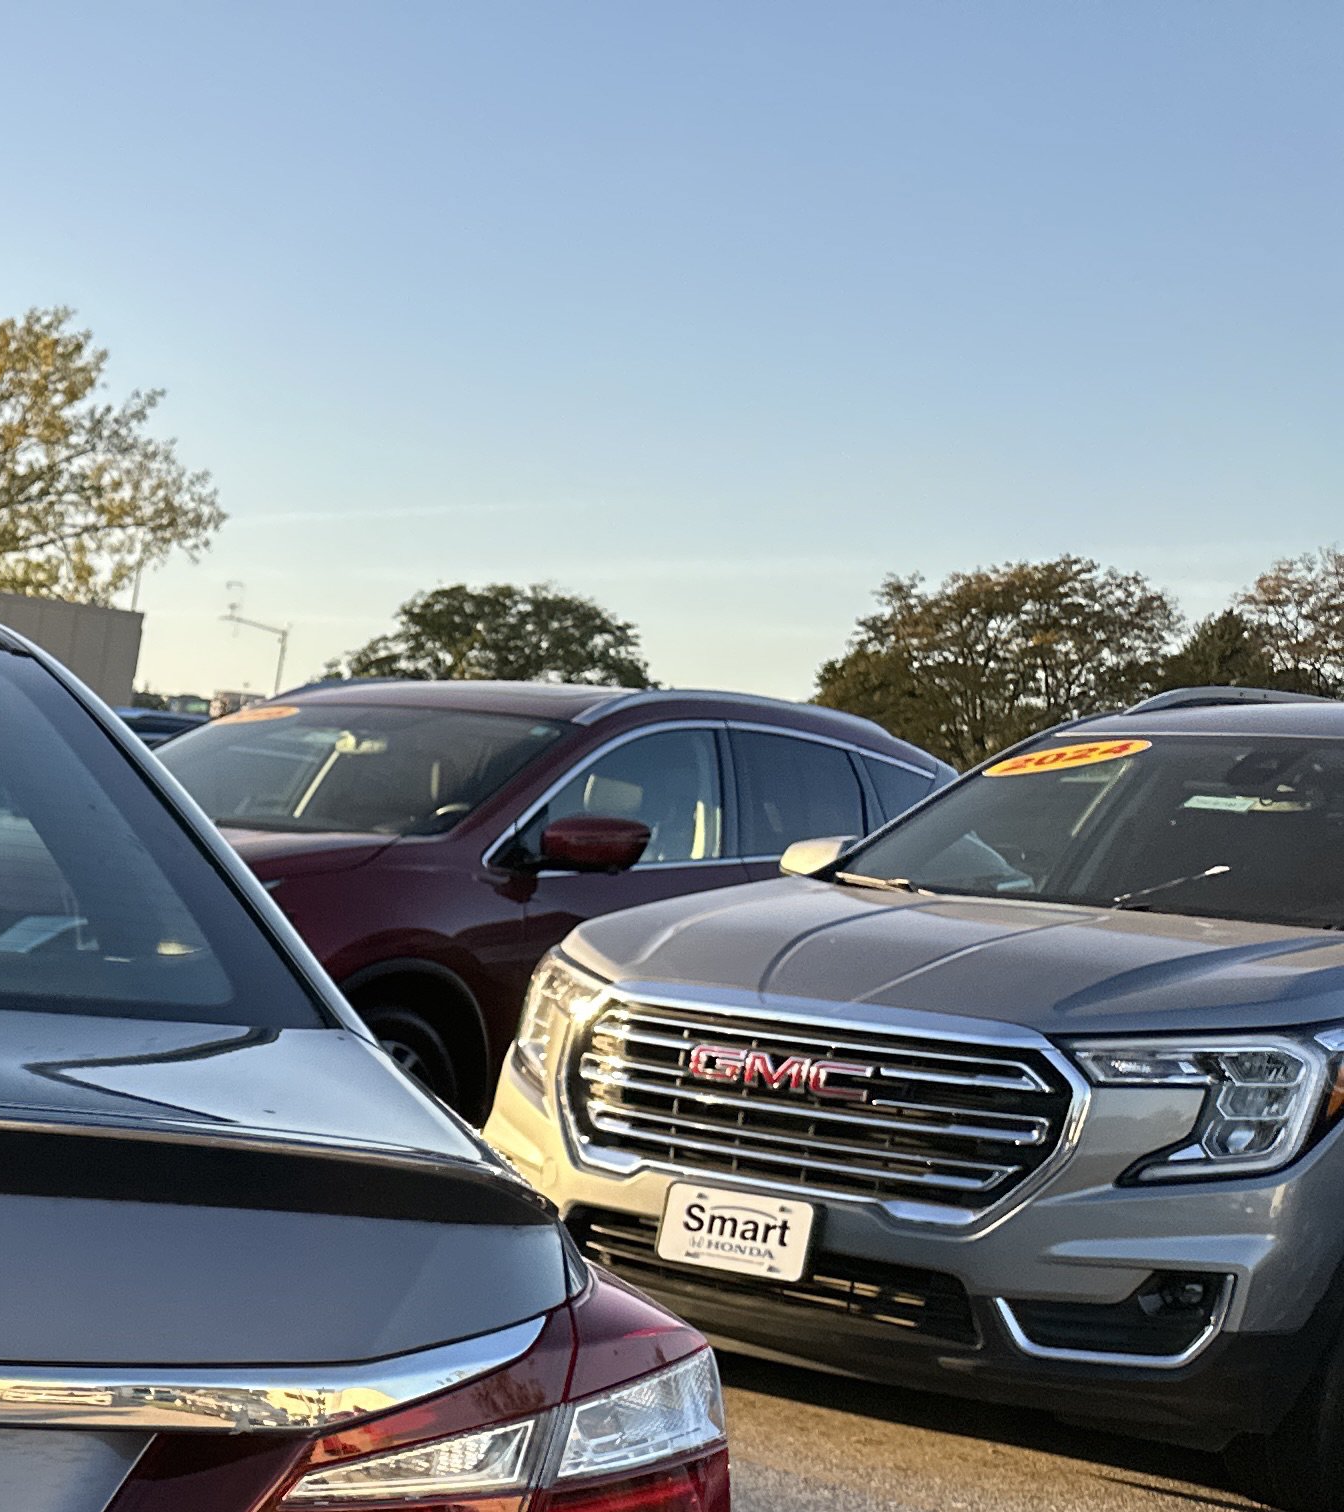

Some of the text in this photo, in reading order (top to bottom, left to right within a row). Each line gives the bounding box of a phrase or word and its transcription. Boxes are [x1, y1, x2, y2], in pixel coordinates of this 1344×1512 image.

[998, 742, 1134, 773] 2024
[690, 1044, 873, 1103] GMC
[683, 1203, 791, 1247] Smart
[706, 1238, 775, 1260] HONDA
